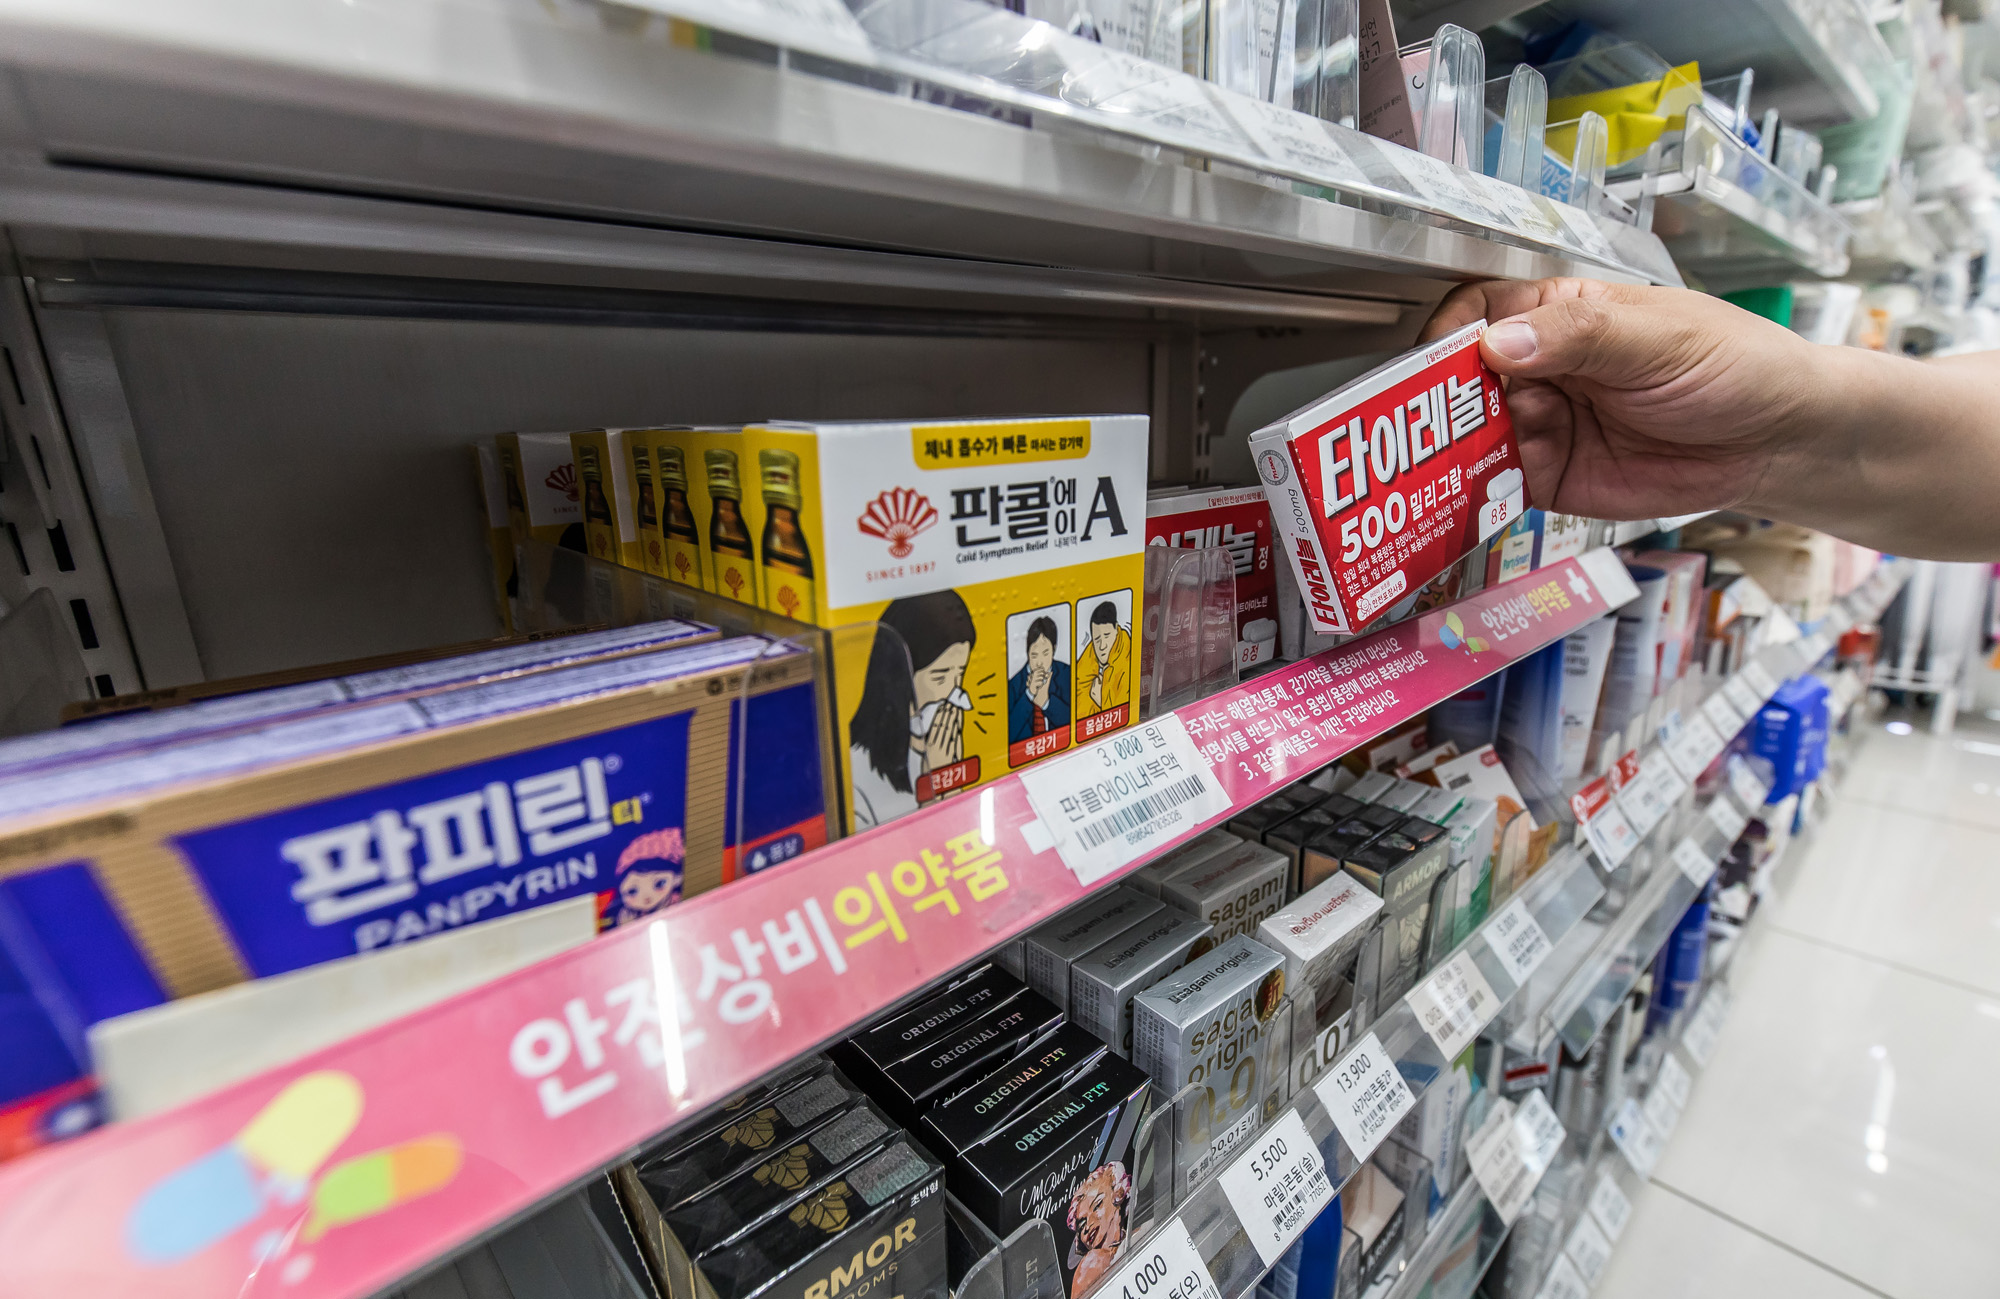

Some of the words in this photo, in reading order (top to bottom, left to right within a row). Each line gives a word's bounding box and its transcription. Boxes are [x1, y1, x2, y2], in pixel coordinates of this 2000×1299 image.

[959, 436, 998, 458] 흡수가
[1002, 435, 1027, 454] 빠른
[1030, 438, 1056, 451] 마시는
[1059, 436, 1084, 450] 감기약
[1317, 374, 1486, 518] 타이레놀
[1488, 387, 1500, 417] 정
[1465, 443, 1508, 480] 아세트아미노펜
[553, 505, 579, 514] SINCE
[950, 479, 1050, 548] 판콜
[1080, 476, 1128, 542] A
[1287, 488, 1309, 534] 500mg
[1341, 491, 1407, 563] 500
[1410, 467, 1462, 522] 밀리그람
[1491, 500, 1507, 525] 8정
[956, 552, 977, 564] Cold
[979, 545, 1024, 563] Symptoms
[1026, 539, 1049, 553] Relief
[1055, 535, 1078, 549] 내복액
[1259, 545, 1268, 570] 정
[1343, 567, 1358, 584] 일일
[1357, 558, 1371, 574] 최대
[1371, 541, 1395, 565] 복용량은
[1418, 515, 1435, 533] 의사나
[1435, 503, 1452, 521] 약사의
[1452, 493, 1468, 511] 지시가
[1347, 582, 1361, 598] 없는
[1371, 564, 1380, 581] 1일
[1381, 556, 1397, 575] 6정을
[1398, 547, 1410, 563] 초과
[1410, 532, 1433, 554] 복용하지
[1433, 517, 1455, 538] 마십시오
[866, 567, 905, 582] SINCE
[910, 561, 937, 575] 1897
[1290, 537, 1340, 628] 타이레놀
[1371, 580, 1403, 609] 안전포장사용
[1480, 580, 1572, 642] 안전상비의약품
[1242, 644, 1259, 663] 8정
[1186, 710, 1231, 739] 주자는
[1226, 682, 1294, 721] 해열진통제,
[1288, 666, 1333, 696] 감기약을
[1329, 650, 1370, 677] 복용하지
[1366, 637, 1402, 661] 마십시오
[1245, 713, 1287, 745] 반드시
[1282, 704, 1310, 728] 읽고
[1306, 678, 1364, 717] 용법/용량에
[1359, 670, 1382, 689] 따라
[1377, 650, 1428, 681] 복용하십시오
[1024, 733, 1057, 757] 목감기
[1085, 709, 1123, 735] 몸살감기
[1097, 738, 1143, 767] 3,000
[1145, 727, 1167, 749] 원
[1238, 761, 1259, 781] 3.
[1253, 746, 1284, 773] 같은
[1280, 728, 1319, 757] 제품은
[1314, 714, 1347, 741] 1개만
[1341, 689, 1400, 727] 구입하십시오
[282, 756, 613, 928] 판피린
[612, 797, 644, 826] 티
[354, 852, 598, 954] PANPYRIN
[1207, 867, 1285, 925] sagami
[1393, 854, 1442, 901] ARMOR
[1148, 918, 1182, 942] original
[510, 829, 1010, 1119] 안전상비의약품
[1216, 948, 1254, 975] original
[901, 1001, 968, 1042] ORIGINAL
[968, 988, 993, 1006] FIT
[930, 1023, 1000, 1069] ORIGINAL
[998, 1012, 1024, 1031] FIT
[1191, 996, 1253, 1056] saga
[974, 1062, 1043, 1115] ORIGINAL
[1041, 1046, 1067, 1067] FIT
[1336, 1053, 1372, 1094] 13,900
[1014, 1099, 1086, 1153] ORIGINAL
[1082, 1081, 1111, 1103] FIT
[1250, 1137, 1288, 1181] 5,500
[1283, 1206, 1306, 1231] 809063
[1308, 1180, 1328, 1203] 770521
